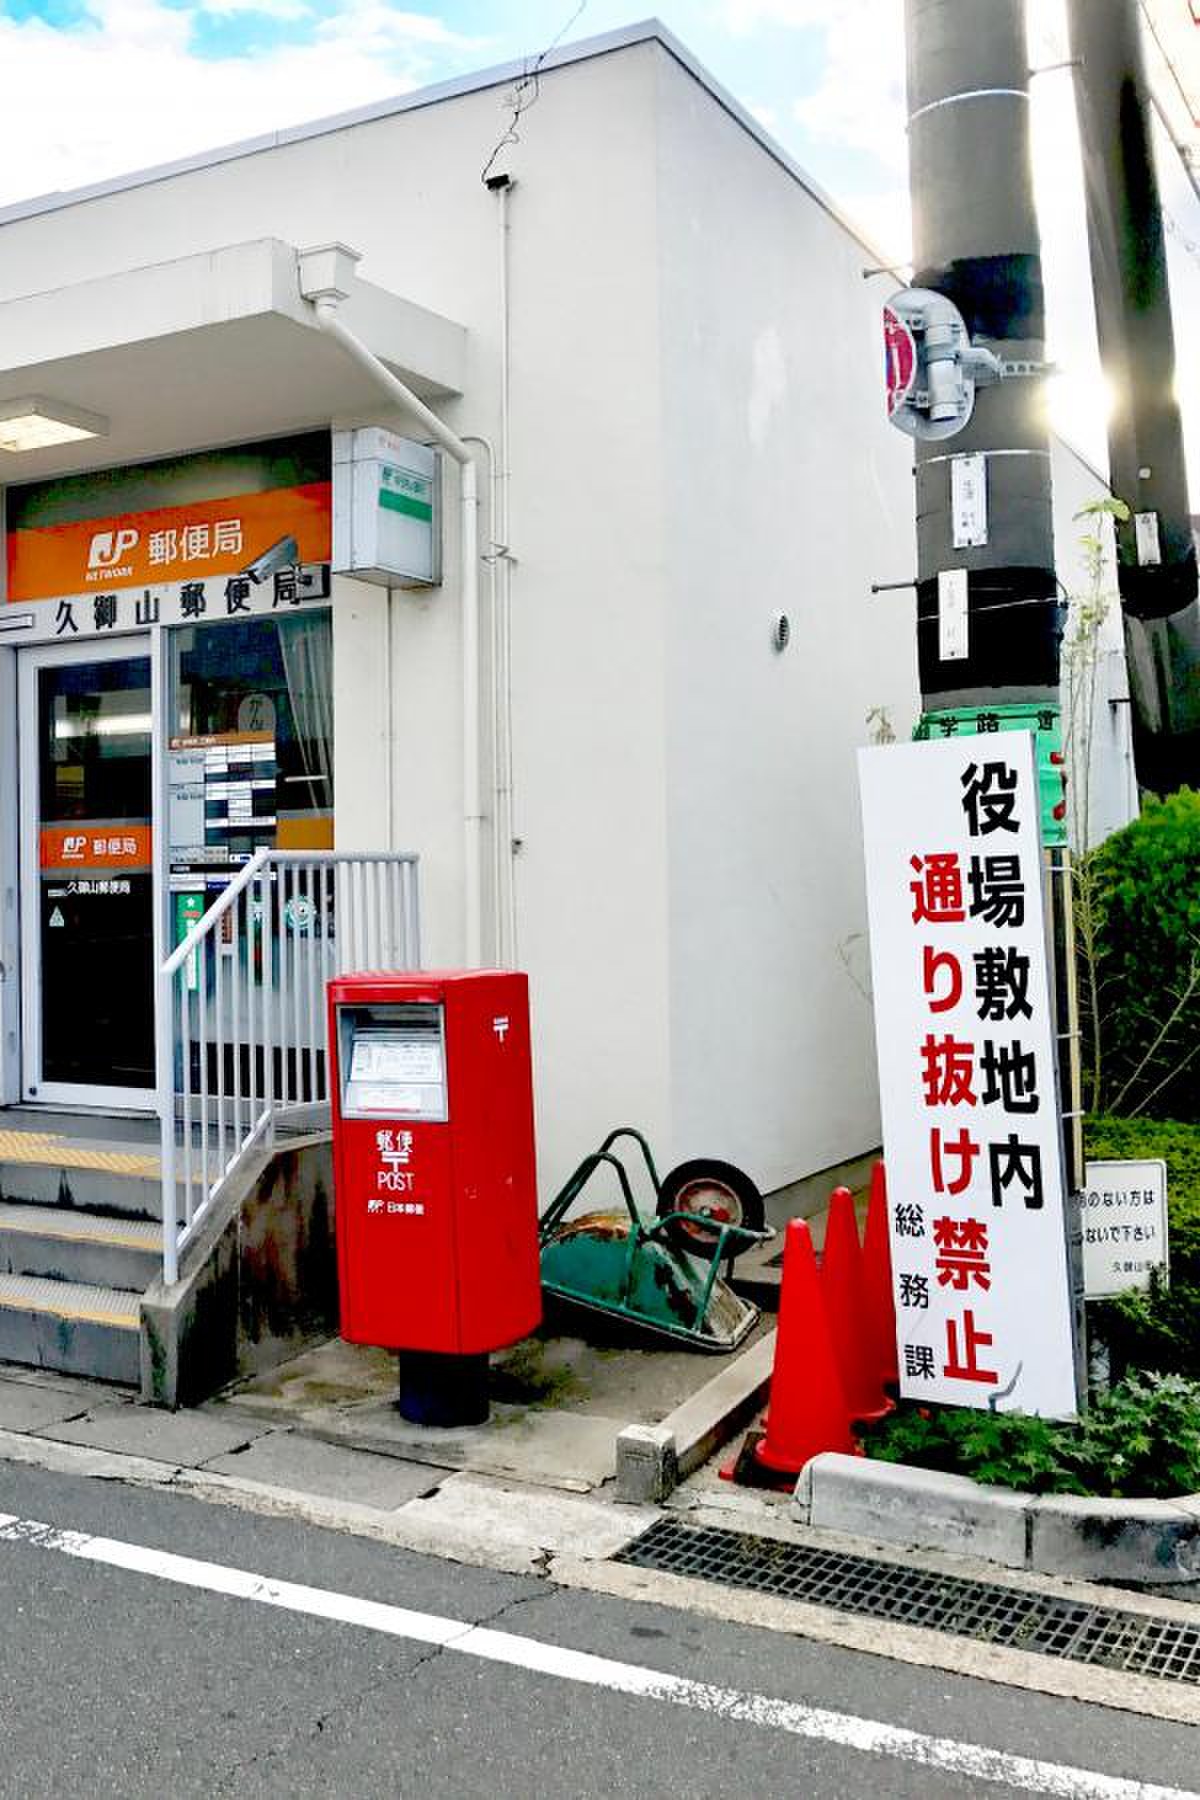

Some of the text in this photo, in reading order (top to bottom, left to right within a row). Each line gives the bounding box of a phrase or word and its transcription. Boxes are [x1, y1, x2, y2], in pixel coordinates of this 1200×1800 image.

[148, 518, 243, 566] 郵便局
[54, 571, 300, 635] 久御山郵便局
[960, 761, 1045, 1211] 役場敷地内
[375, 1130, 413, 1153] 郵便
[908, 852, 1000, 1387] 通り抜け禁止
[377, 1171, 415, 1191] POST
[894, 1202, 935, 1382] 総務課
